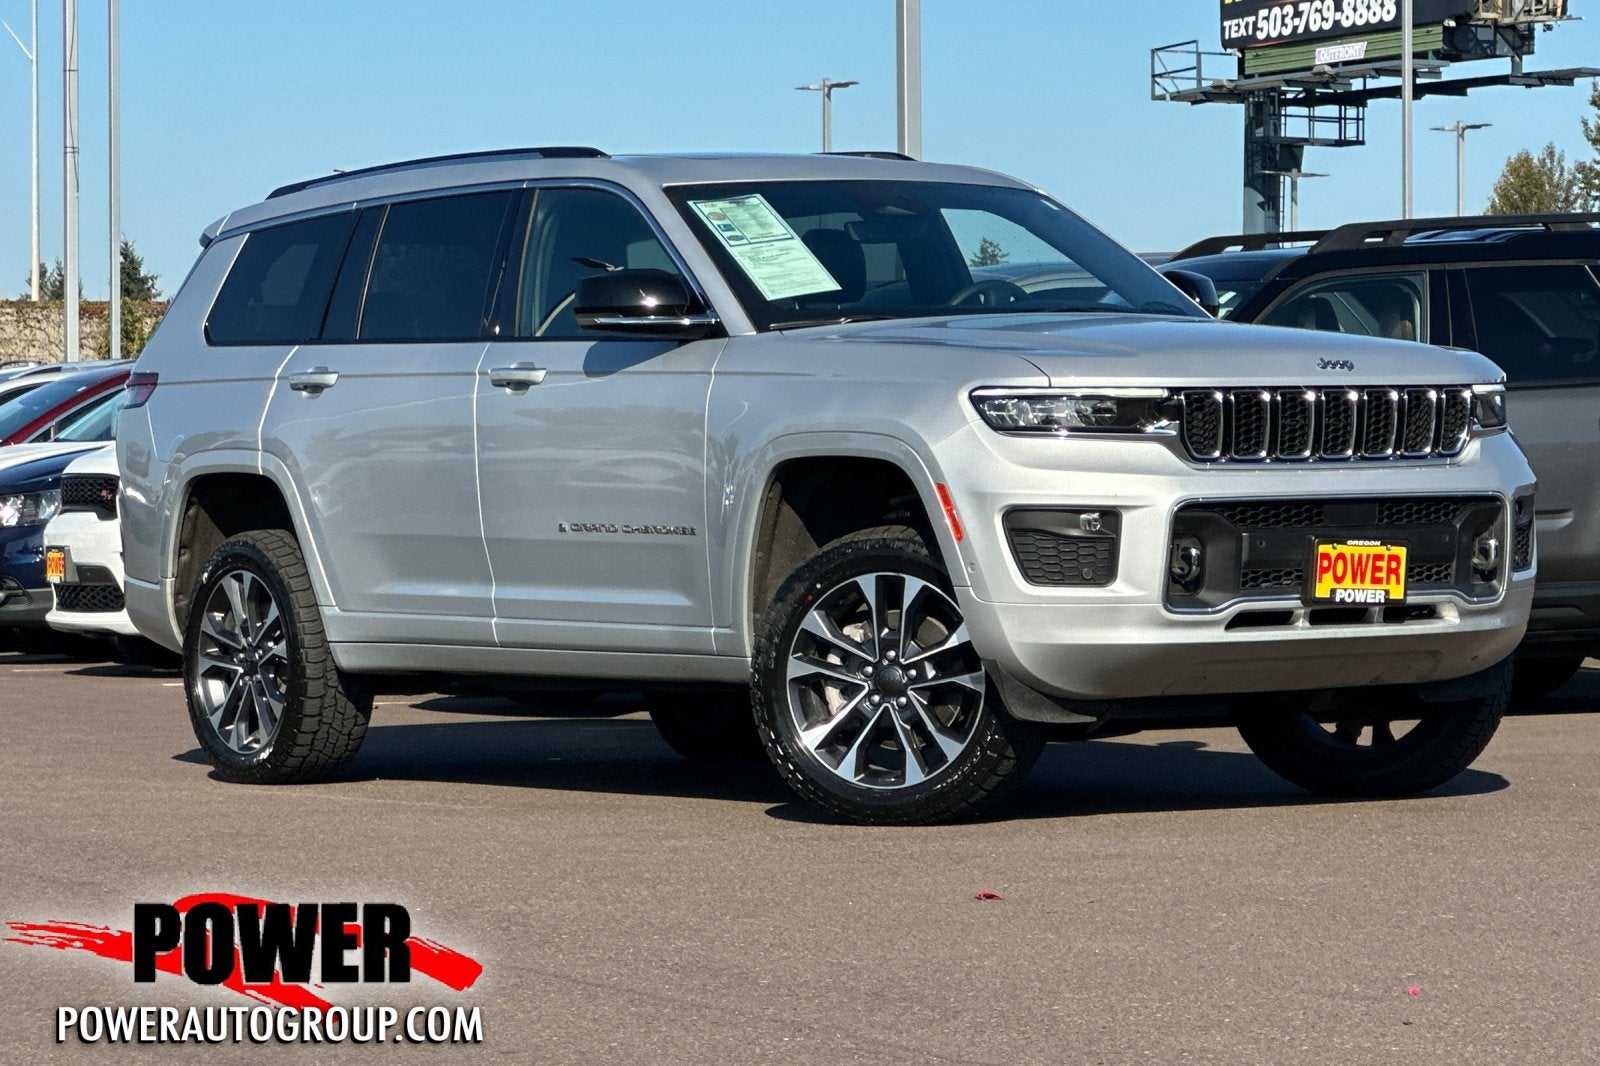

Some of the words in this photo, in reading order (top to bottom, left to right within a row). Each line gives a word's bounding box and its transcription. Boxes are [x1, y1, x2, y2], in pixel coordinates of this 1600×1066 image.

[1223, 16, 1256, 40] TEXT
[1256, 0, 1397, 40] 503-769-8888
[1320, 45, 1362, 61] OUTFRONT
[1317, 357, 1355, 371] Jeep
[570, 523, 618, 533] GRAND
[622, 525, 696, 536] CHEROKEE
[1318, 552, 1402, 585] POWER
[1335, 589, 1385, 603] POWER
